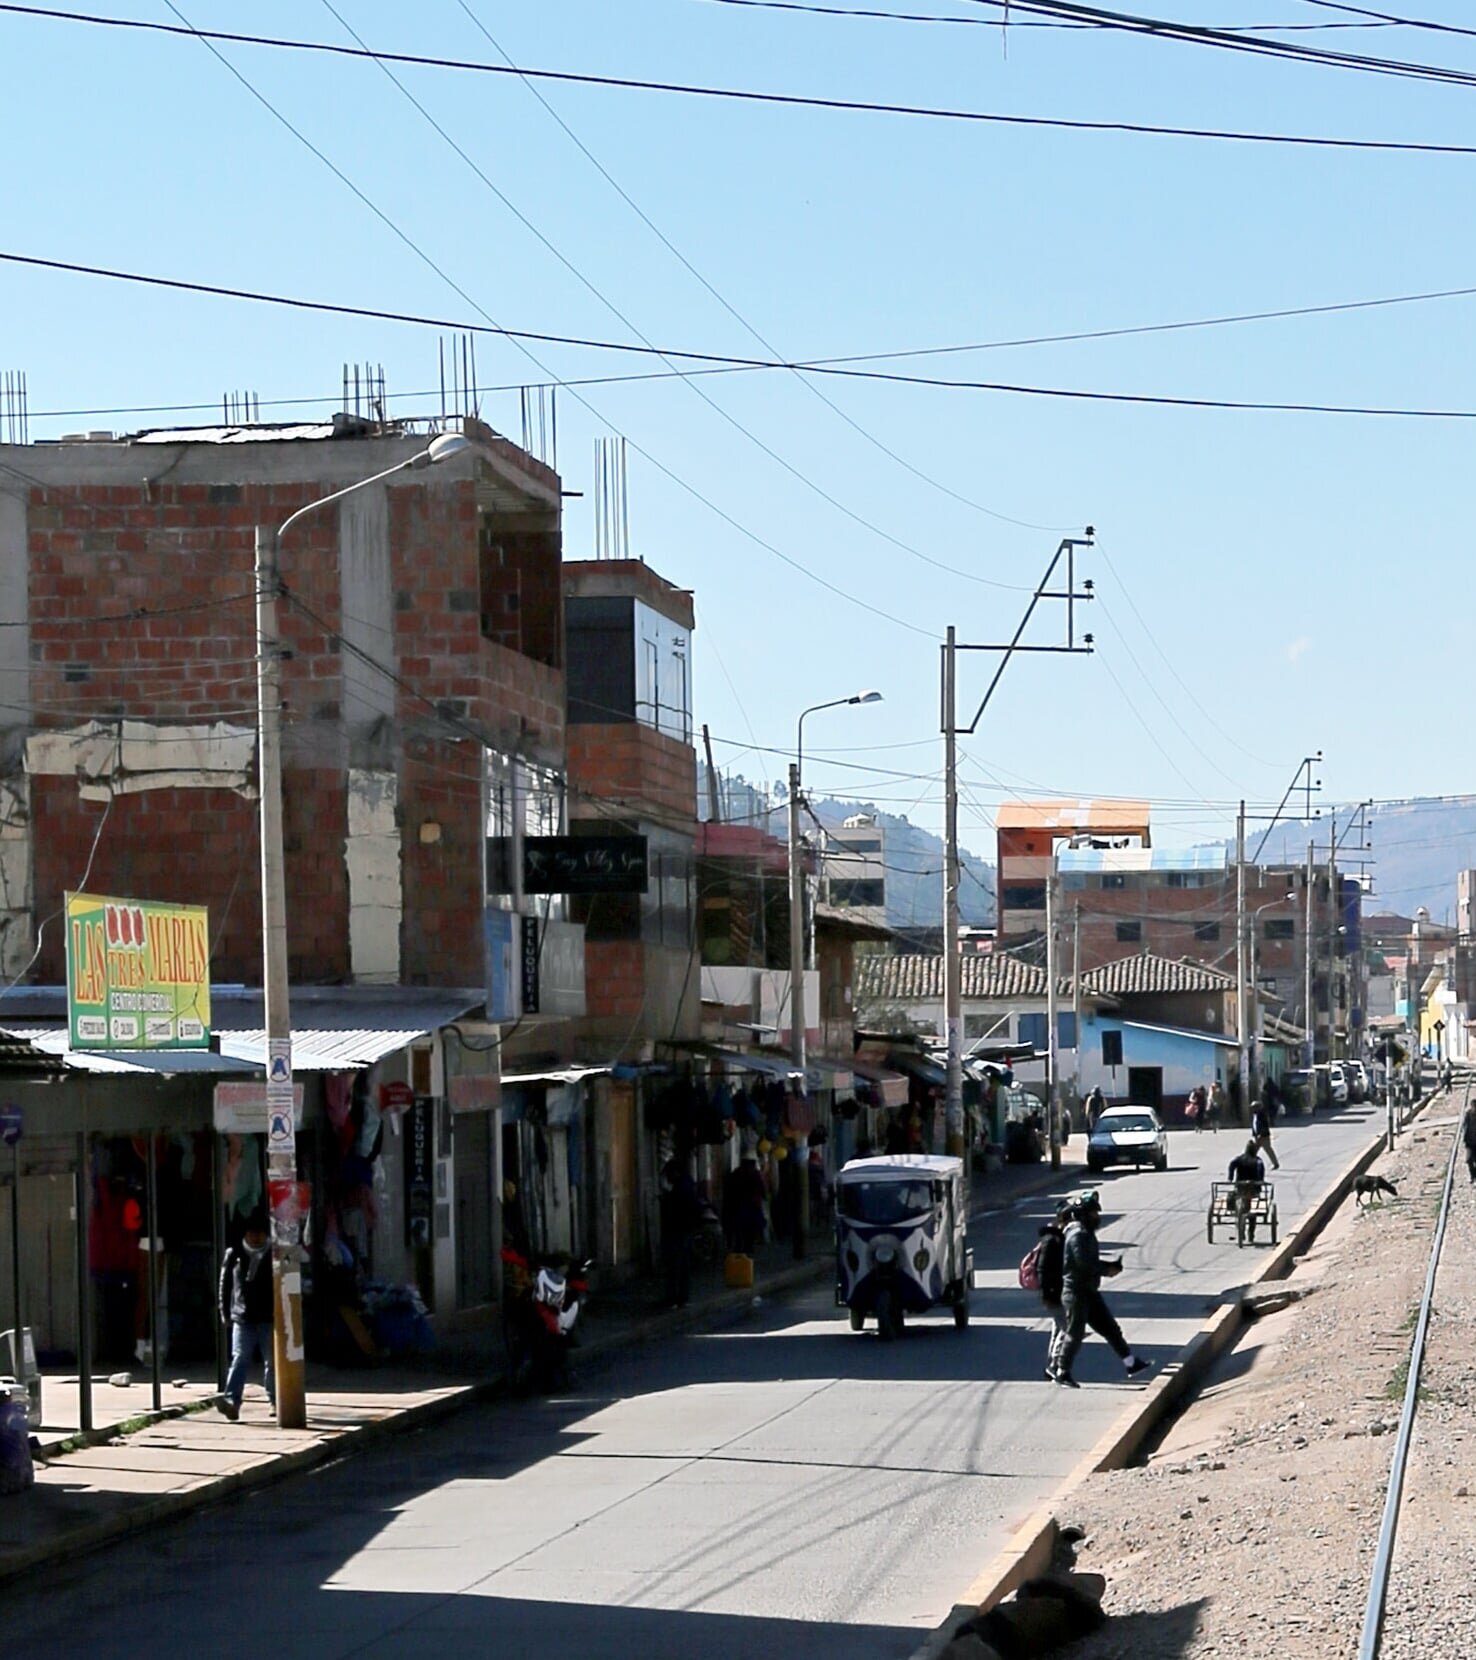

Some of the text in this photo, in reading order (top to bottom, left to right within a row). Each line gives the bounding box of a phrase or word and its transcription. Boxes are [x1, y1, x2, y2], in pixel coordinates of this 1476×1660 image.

[73, 914, 206, 1004] LAS TRES MARIAS
